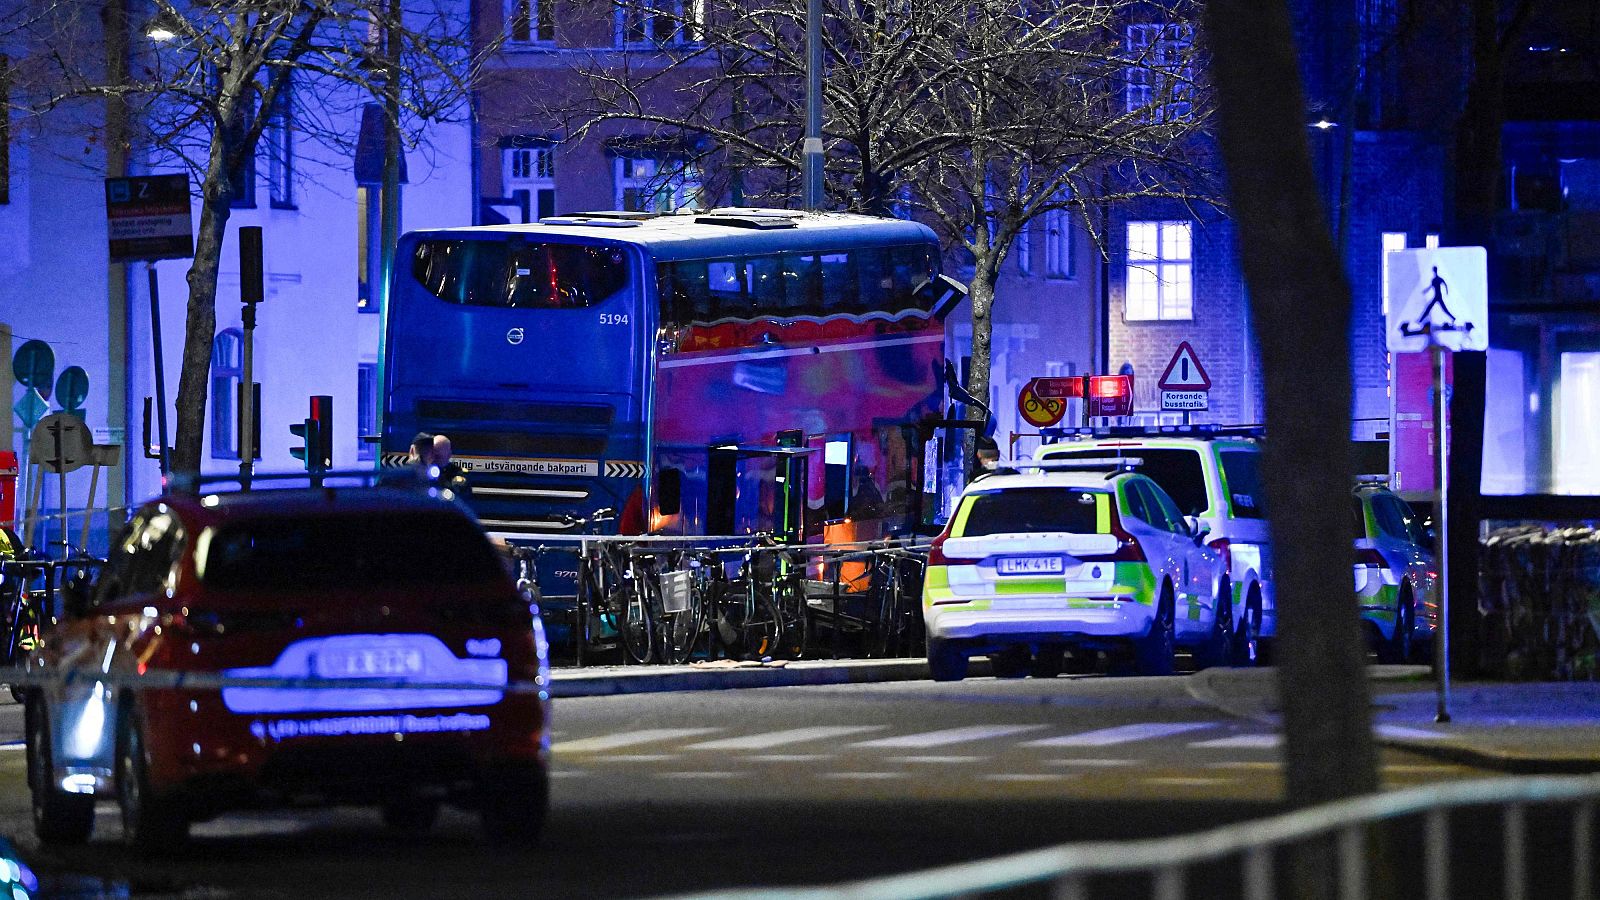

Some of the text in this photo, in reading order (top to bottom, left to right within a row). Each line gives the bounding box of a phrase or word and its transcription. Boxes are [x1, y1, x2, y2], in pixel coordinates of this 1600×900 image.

[599, 313, 629, 325] 5194
[1166, 392, 1203, 400] Korsande
[1164, 400, 1204, 408] busstrafik
[451, 459, 473, 470] ning
[484, 462, 544, 472] utsvängande
[547, 463, 587, 474] bakparti
